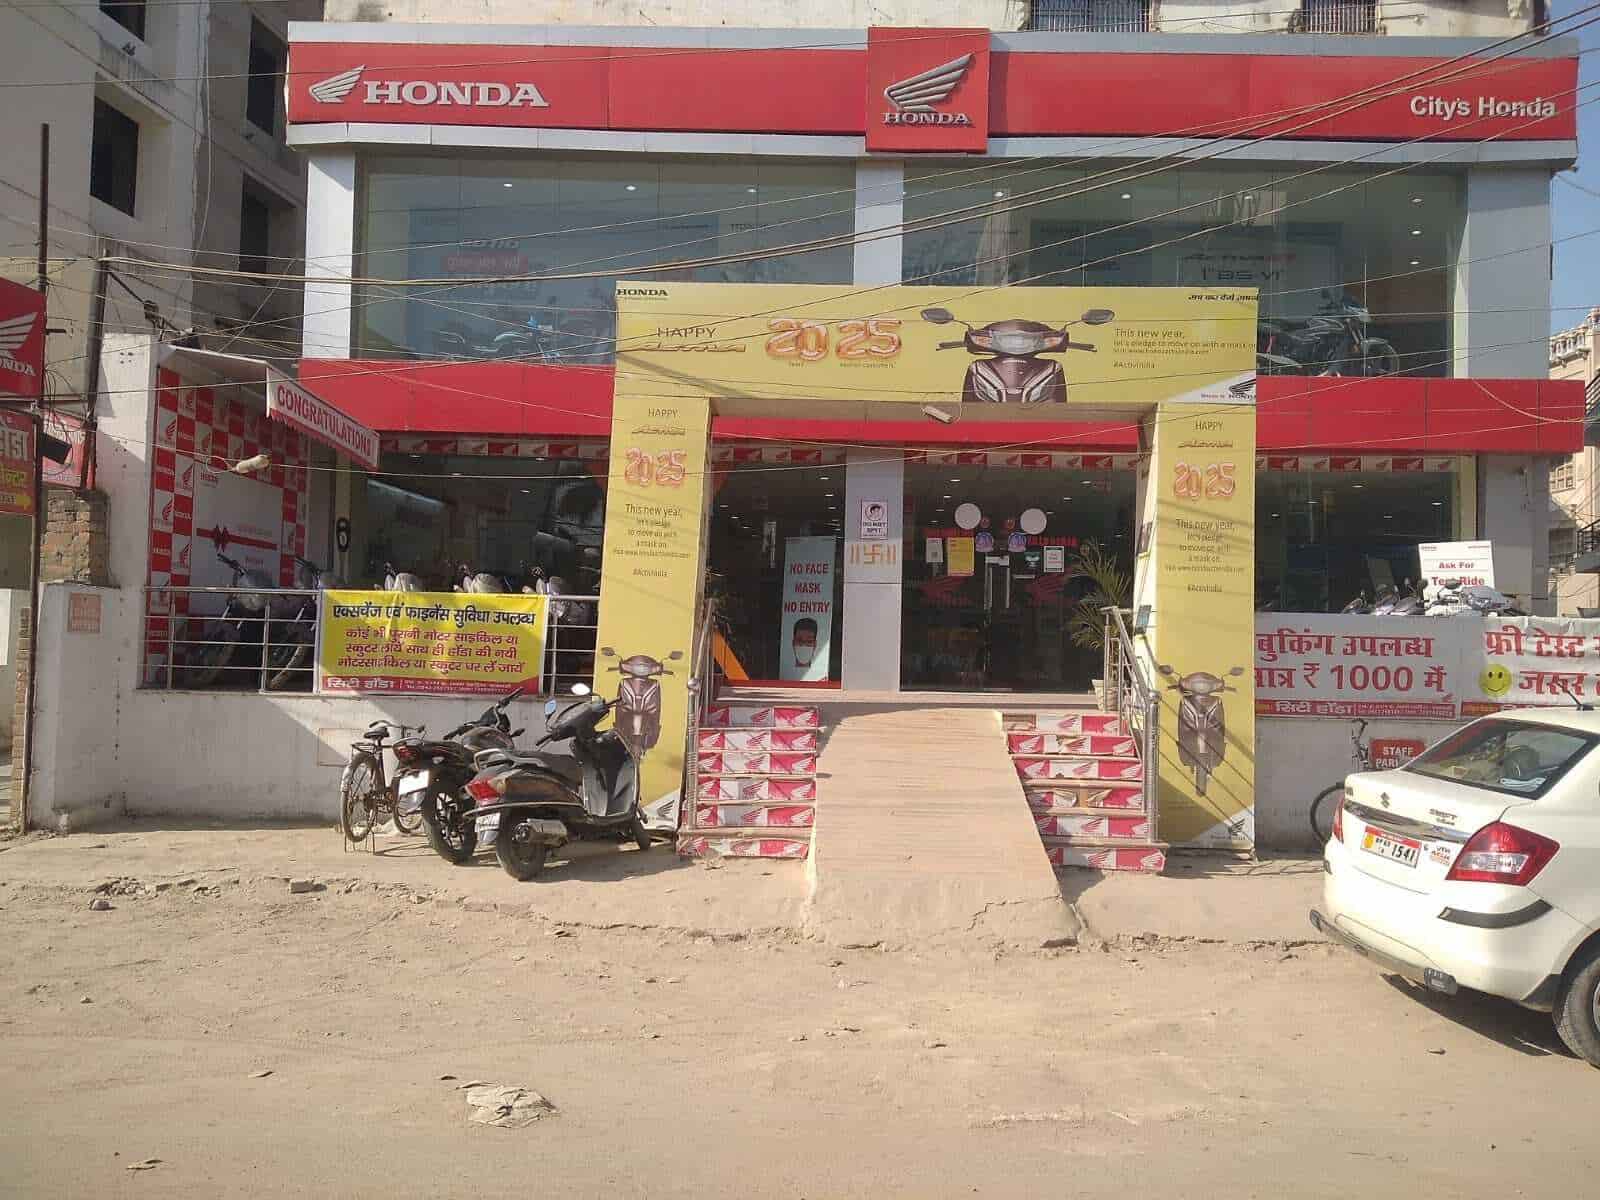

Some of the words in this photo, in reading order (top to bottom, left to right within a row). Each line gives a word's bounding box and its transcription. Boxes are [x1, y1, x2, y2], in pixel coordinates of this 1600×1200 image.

[363, 80, 549, 107] HONDA
[1410, 95, 1471, 120] City's
[1478, 96, 1556, 118] Honda
[881, 112, 972, 126] HONDA
[617, 288, 668, 297] HONDA
[657, 327, 717, 338] HAPPY
[1115, 328, 1134, 337] This
[0, 358, 36, 376] NDA
[648, 408, 678, 418] HAPPY
[1195, 421, 1224, 431] HAPPY
[625, 503, 643, 513] This
[644, 506, 663, 516] new
[1176, 518, 1192, 529] This
[790, 563, 802, 574] NO
[805, 563, 829, 575] FACE
[1438, 561, 1456, 569] Ask
[1459, 561, 1474, 569] For
[1459, 576, 1485, 586] Ride
[795, 582, 821, 594] MASK
[784, 600, 798, 613] NO
[800, 601, 830, 613] ENTRY
[453, 605, 490, 627] सुविधा
[345, 628, 369, 640] कोई
[1256, 627, 1336, 662] बुकिंग
[1533, 627, 1586, 658] टेस्ट
[475, 645, 491, 658] की
[327, 676, 360, 689] सिटी
[1330, 664, 1413, 692] 1000
[1424, 665, 1447, 692] में
[1383, 746, 1414, 757] STAFF
[1391, 844, 1416, 863] 1541
